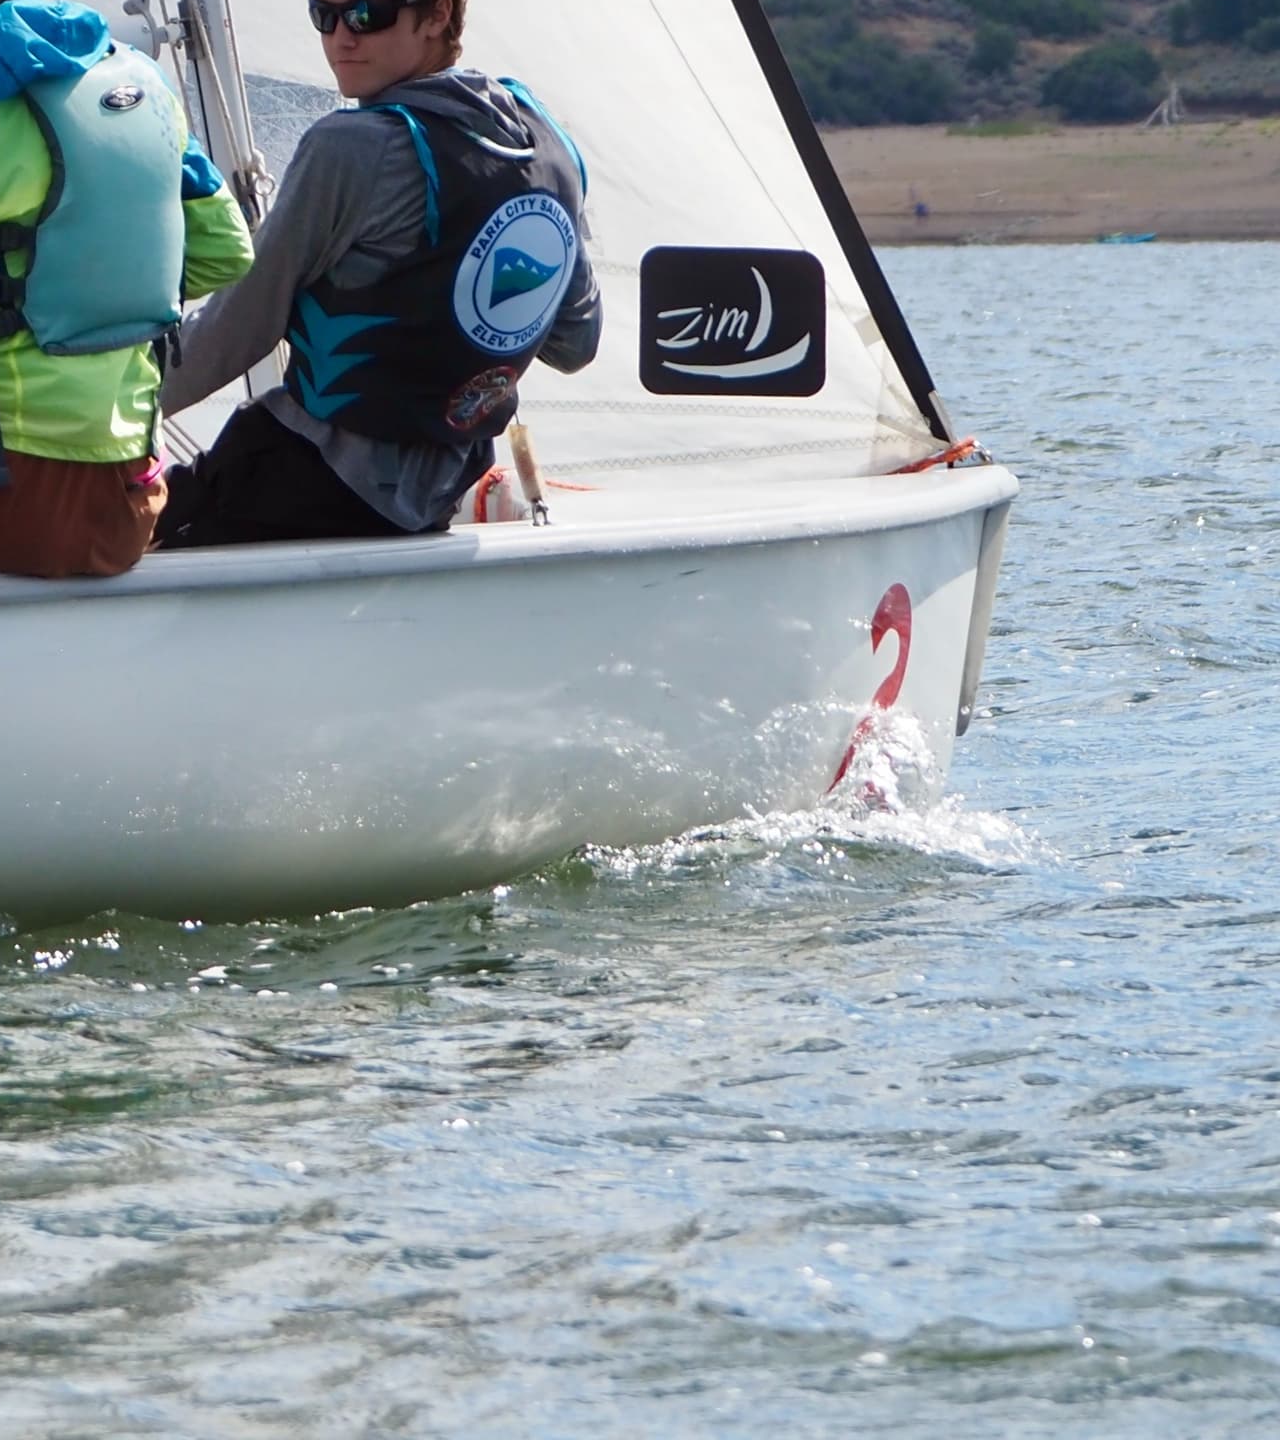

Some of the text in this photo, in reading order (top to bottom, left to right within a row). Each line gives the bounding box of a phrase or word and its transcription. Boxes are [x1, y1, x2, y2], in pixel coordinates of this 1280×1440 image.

[470, 197, 574, 259] PARK CITY SAILING
[470, 323, 508, 348] ELEV.
